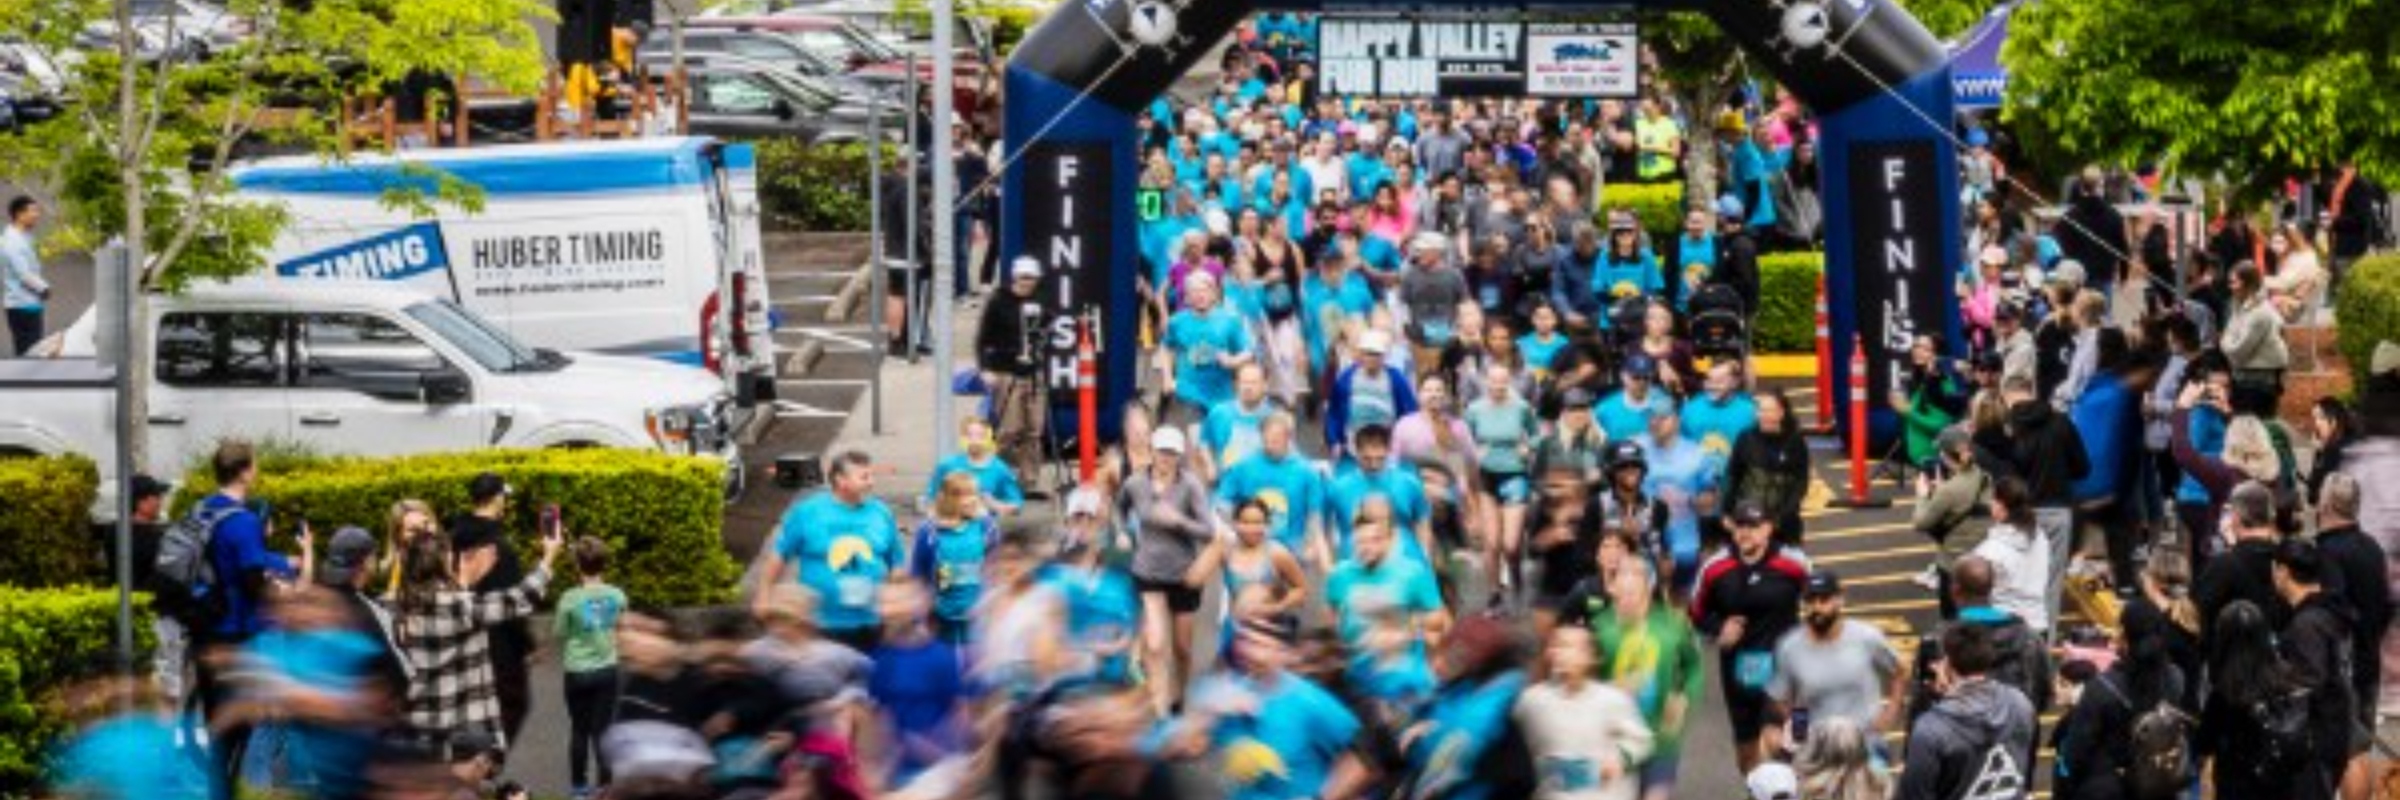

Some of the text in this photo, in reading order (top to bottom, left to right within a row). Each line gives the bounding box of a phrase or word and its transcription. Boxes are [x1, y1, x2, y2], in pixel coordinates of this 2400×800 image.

[1319, 20, 1413, 57] HAPPY
[1420, 22, 1521, 60] VALLEY
[1319, 58, 1438, 94] FUN RUN
[472, 228, 665, 269] HUBER TIMING
[1050, 155, 1083, 389] FINISH
